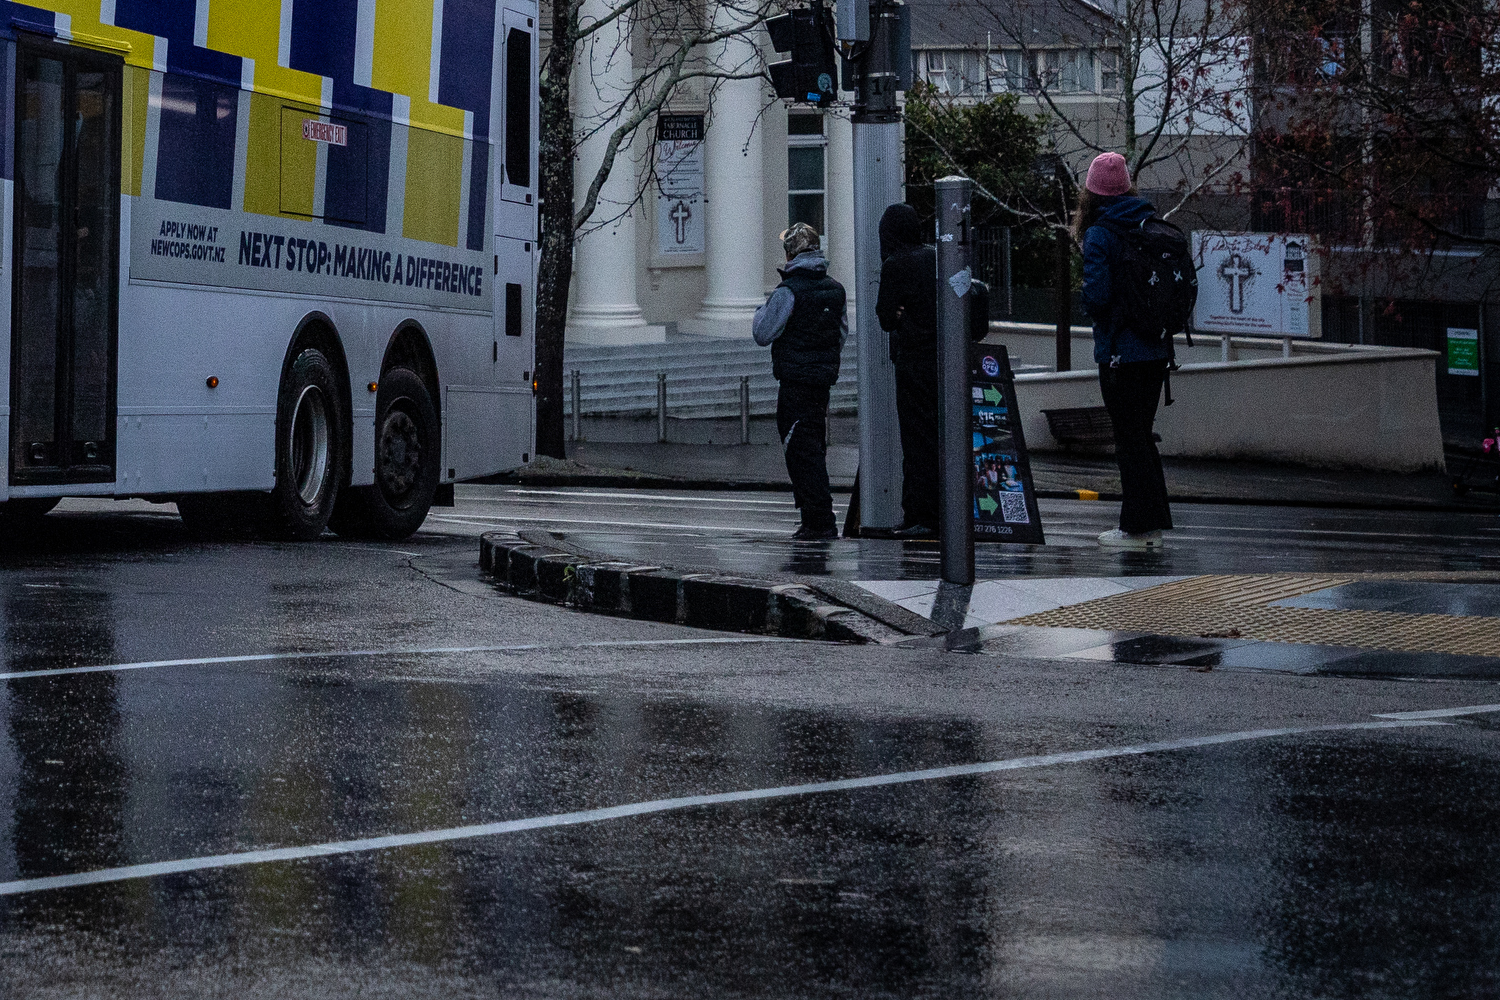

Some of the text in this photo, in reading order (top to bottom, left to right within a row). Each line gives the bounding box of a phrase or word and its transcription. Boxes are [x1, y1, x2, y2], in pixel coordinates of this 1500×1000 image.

[663, 130, 698, 139] CHURCH
[160, 220, 219, 243] APPLY NOW AT
[151, 239, 226, 263] NEWCOPS.GOVT.NZ
[238, 230, 483, 297] NEXT STOP: MAKING A DIFFERENCE
